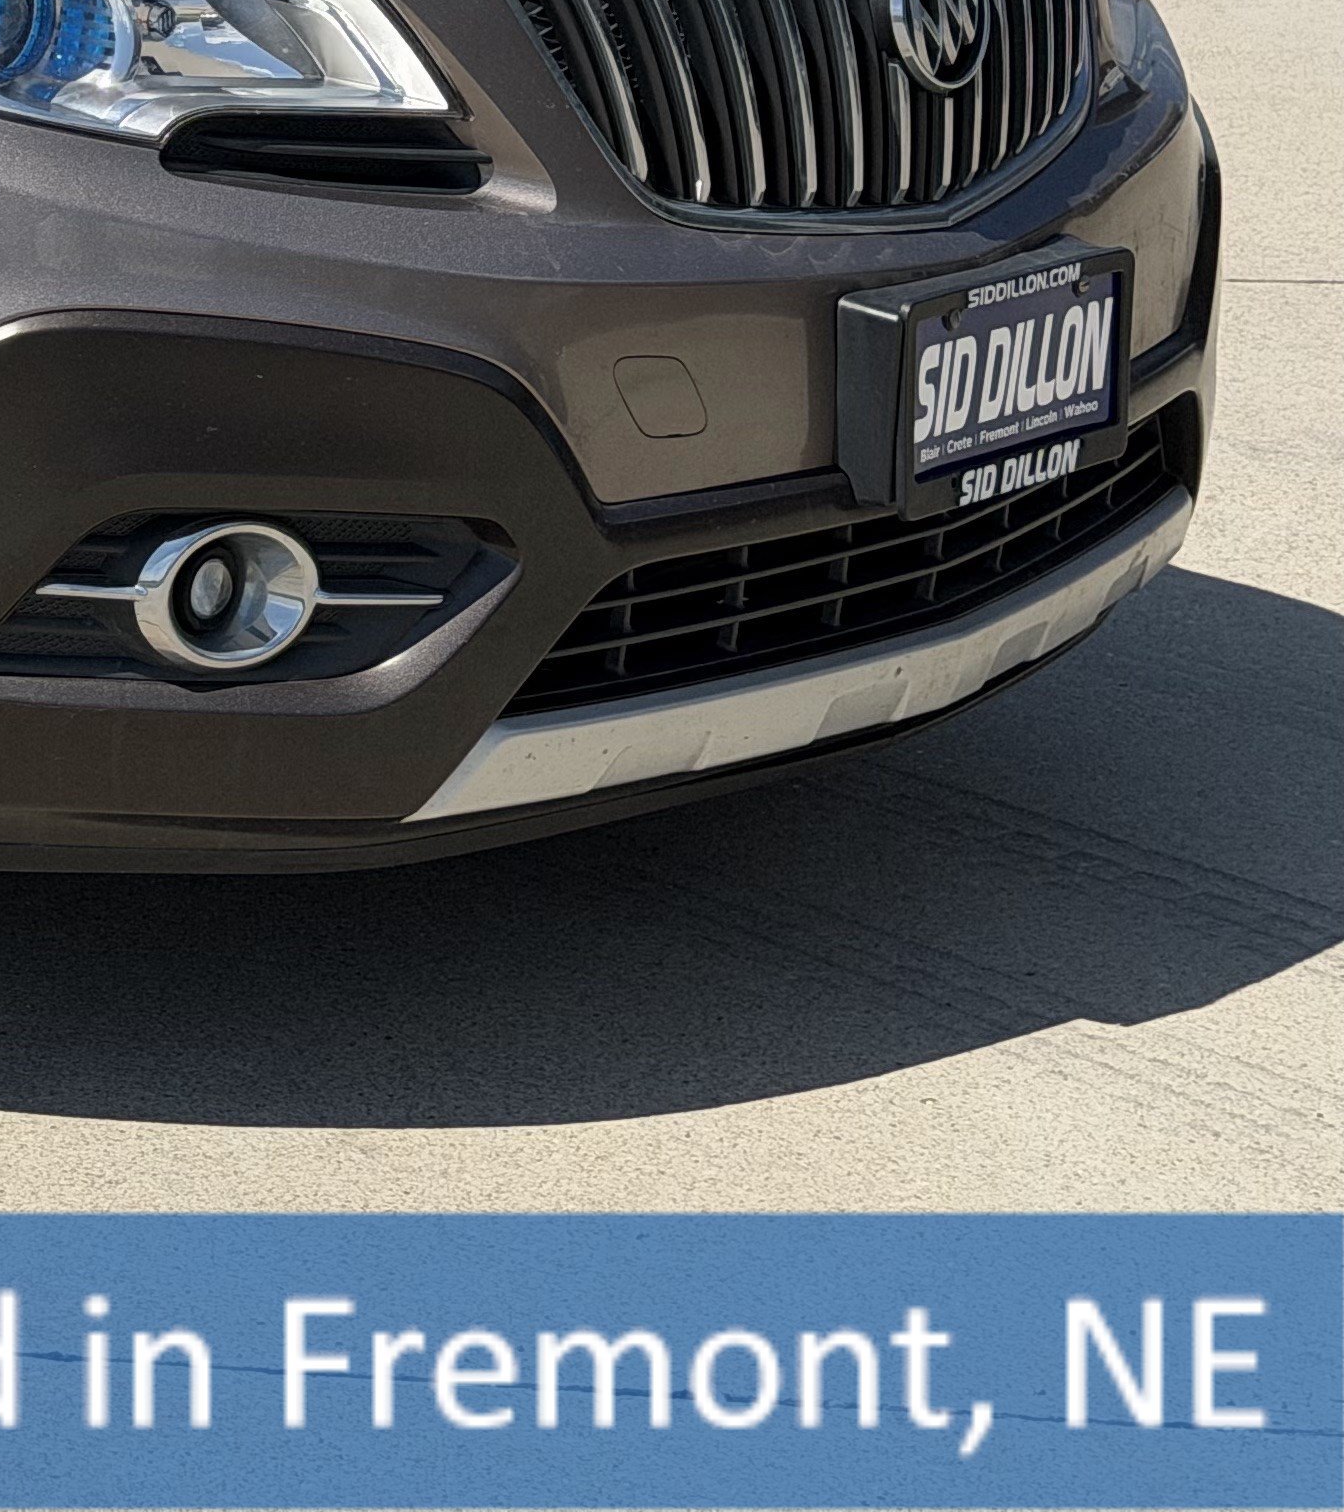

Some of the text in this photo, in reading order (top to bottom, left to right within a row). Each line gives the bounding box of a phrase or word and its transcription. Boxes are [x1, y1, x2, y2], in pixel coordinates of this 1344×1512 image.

[967, 262, 1082, 309] SIDDILLON.COM
[914, 296, 1114, 444] SID DILLON
[947, 435, 973, 455] Crete
[979, 423, 1019, 443] Fremont
[1025, 409, 1058, 431] Lincoln
[1064, 400, 1099, 419] Wahoo
[959, 438, 1081, 507] SID DILLON
